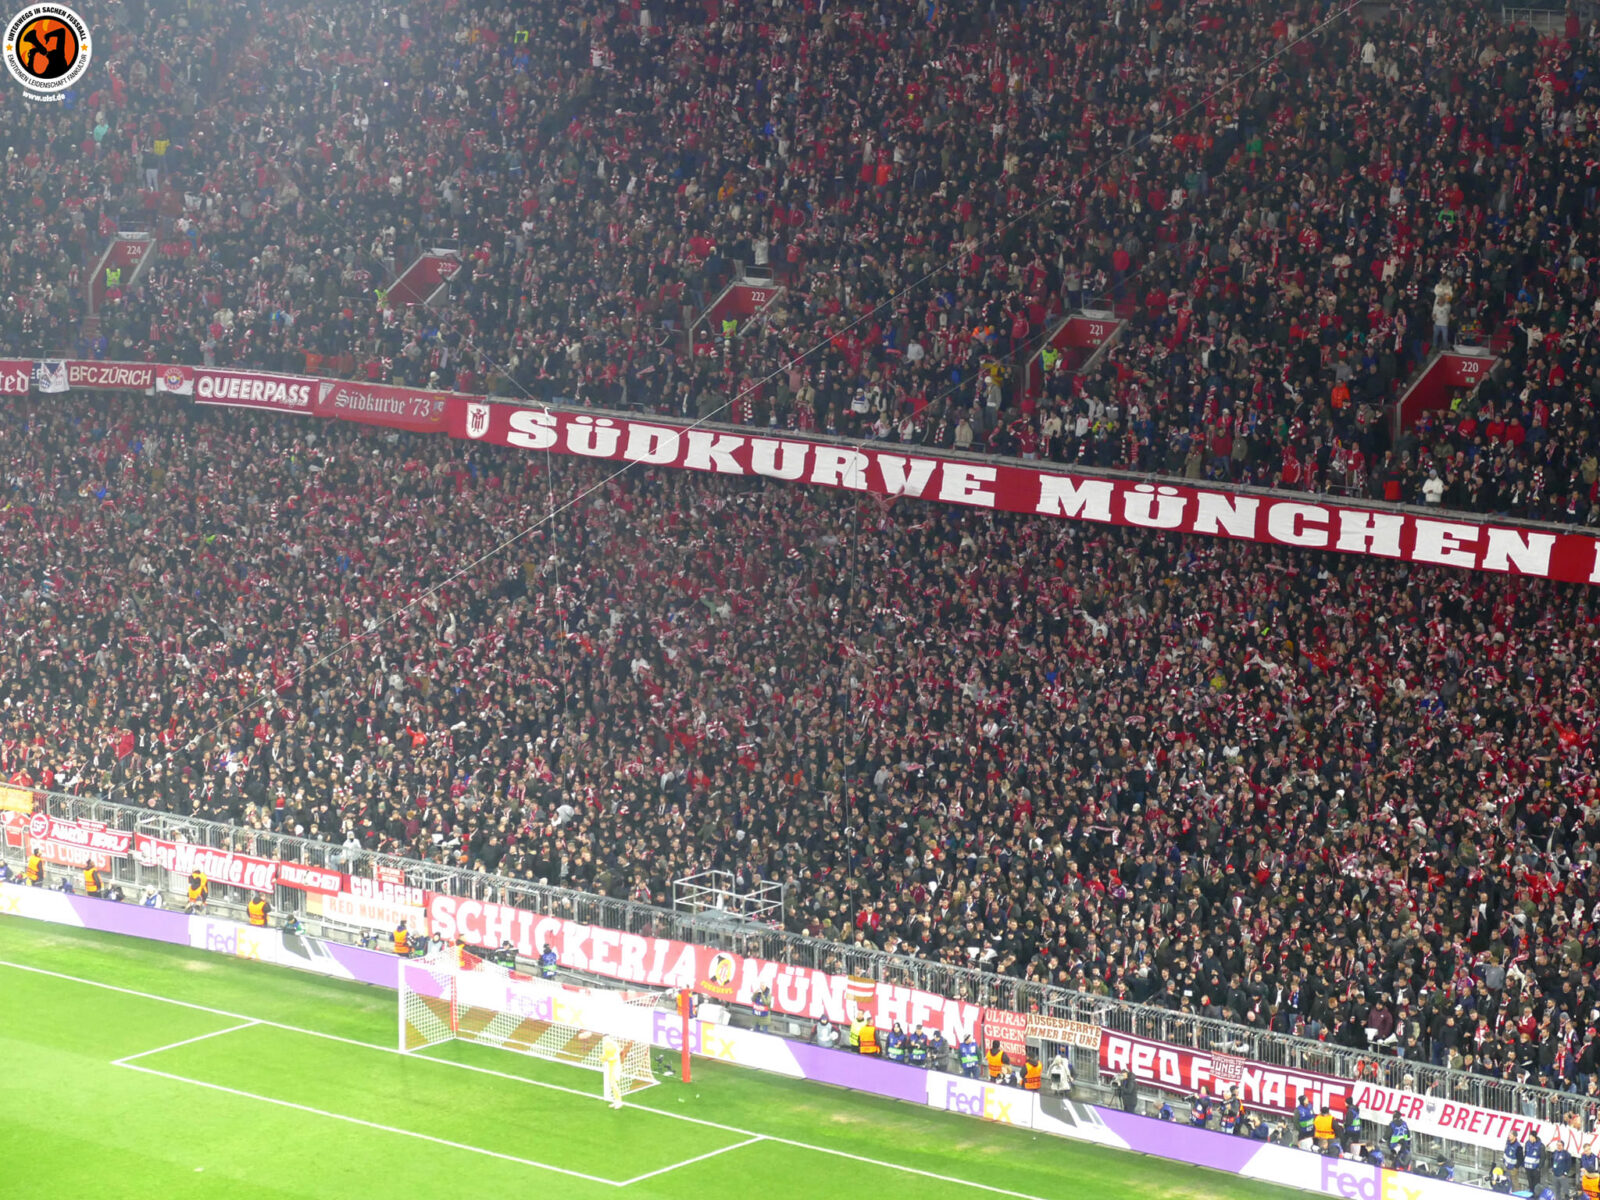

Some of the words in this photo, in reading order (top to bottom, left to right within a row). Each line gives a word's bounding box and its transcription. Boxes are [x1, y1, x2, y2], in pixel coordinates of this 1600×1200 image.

[127, 245, 141, 255] 224
[751, 291, 766, 302] 222
[1089, 324, 1104, 336] 221
[69, 367, 98, 382] BFC
[99, 366, 152, 386] ZÜRICH
[1461, 361, 1479, 373] 220
[197, 376, 311, 406] QUEERPASS
[335, 388, 406, 415] Südkurve
[507, 410, 998, 507] SÜDKURVE
[1035, 474, 1556, 577] MÜNCHEN
[206, 923, 262, 959] FedEx
[431, 896, 697, 990] SCHICKERIA
[985, 1008, 1026, 1027] ULTRAS
[1027, 1014, 1102, 1037] AUSGESPERRTE
[652, 1010, 736, 1061] FedEx
[984, 1024, 1025, 1043] GEGEN
[1026, 1026, 1059, 1040] IMMER
[1061, 1030, 1078, 1044] BEI
[1079, 1034, 1099, 1048] UNS
[945, 1079, 1013, 1124] FedEx
[1356, 1086, 1425, 1121] ADLER
[1438, 1103, 1542, 1144] BRETTEN
